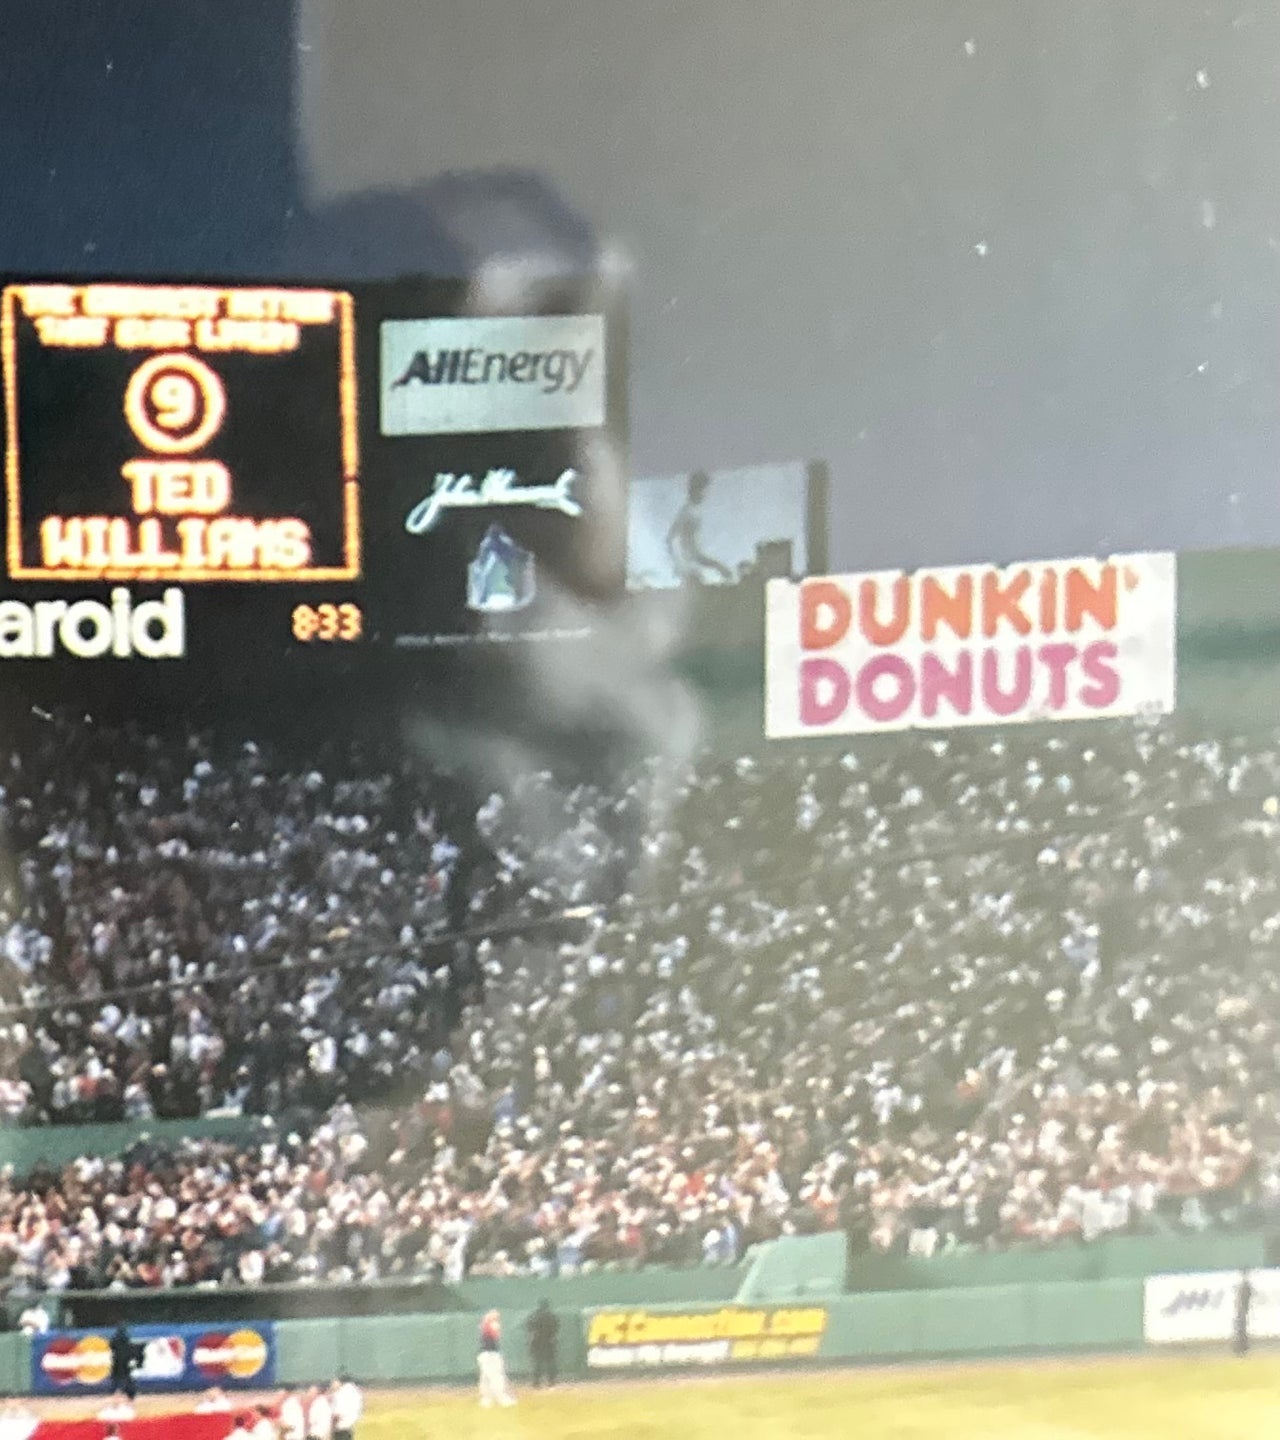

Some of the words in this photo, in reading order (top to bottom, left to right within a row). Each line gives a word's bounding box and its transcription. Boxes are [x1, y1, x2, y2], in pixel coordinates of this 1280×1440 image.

[390, 348, 595, 394] AllEnergy
[151, 374, 196, 430] 9
[122, 459, 232, 515] TED
[40, 516, 312, 570] WILLIAMS
[799, 564, 1140, 651] DUNKIN'
[798, 639, 1122, 727] DONUTS
